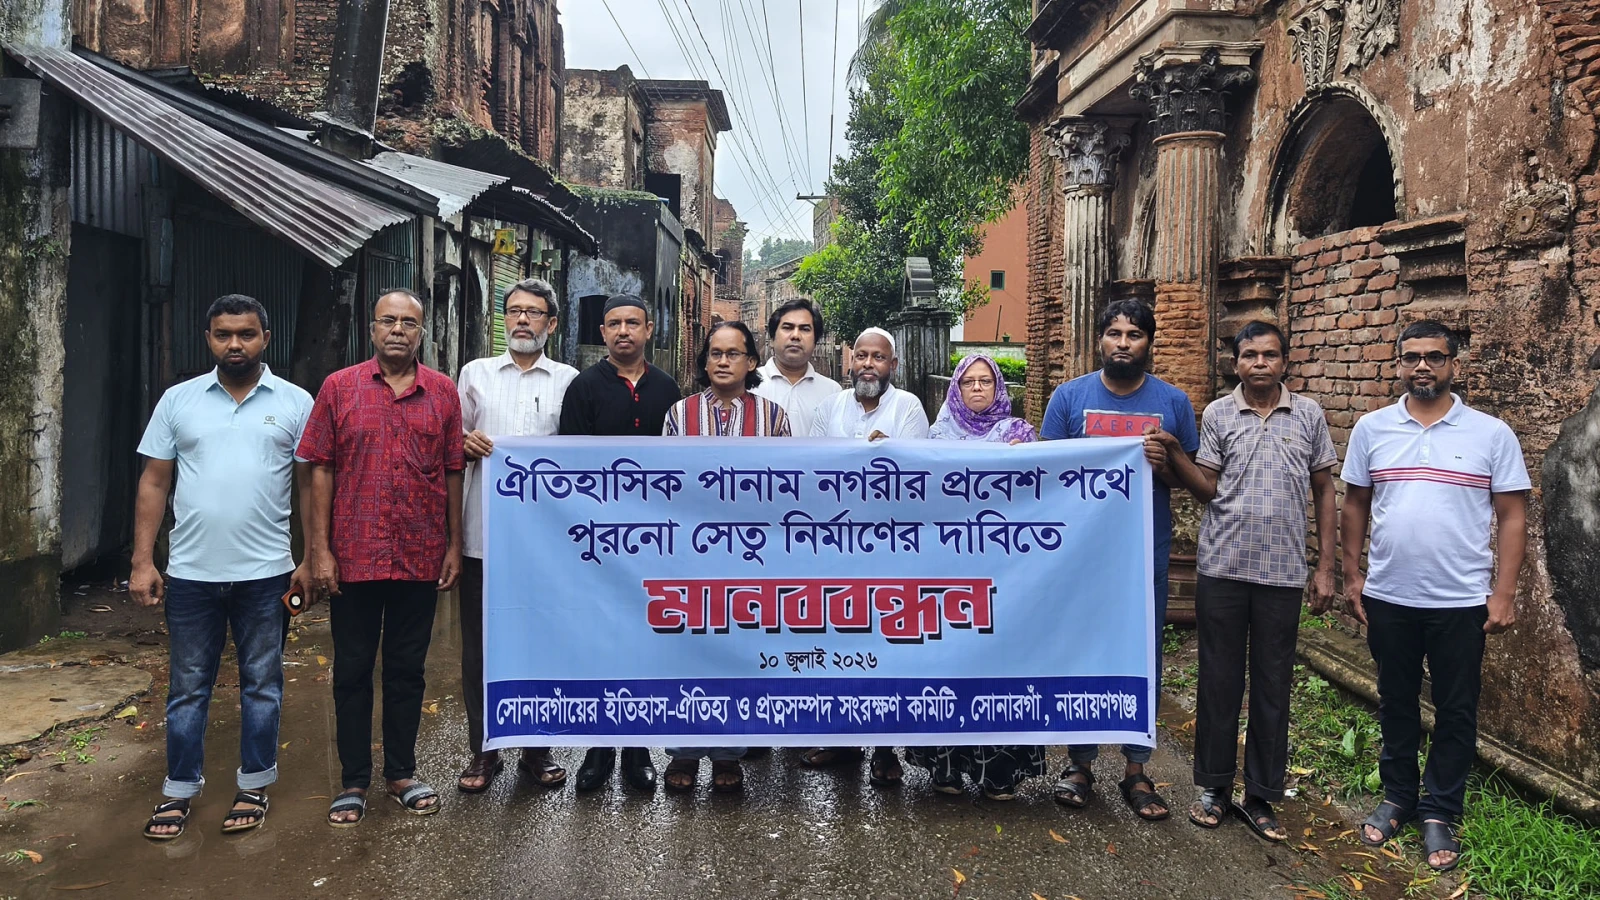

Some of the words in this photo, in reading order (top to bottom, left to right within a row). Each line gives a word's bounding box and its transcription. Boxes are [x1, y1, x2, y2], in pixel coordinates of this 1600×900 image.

[496, 455, 686, 505] ঐতিহাসিক
[697, 466, 805, 503] পানাম
[813, 457, 932, 503] নগরীর
[941, 466, 1048, 504] প্রবেশ
[1058, 463, 1136, 501] পথে
[567, 518, 681, 565] পুরনো
[691, 521, 772, 566] সেতু
[778, 509, 926, 555] নির্মাণের
[932, 509, 1067, 555] দাবিতে
[642, 577, 998, 645] মানববন্ধন
[759, 651, 779, 670] ১০
[784, 645, 827, 674] জুলাই
[832, 651, 878, 671] ২০২৬
[496, 687, 600, 725] সোনারগাঁয়ের
[603, 684, 732, 726] ইতিহাস-ঐতিহ্য
[735, 697, 750, 721] ও
[755, 692, 835, 728] প্রত্নসম্পদ
[837, 692, 902, 725] সংরক্ষণ
[1053, 690, 1138, 722] নারায়ণগঞ্জ
